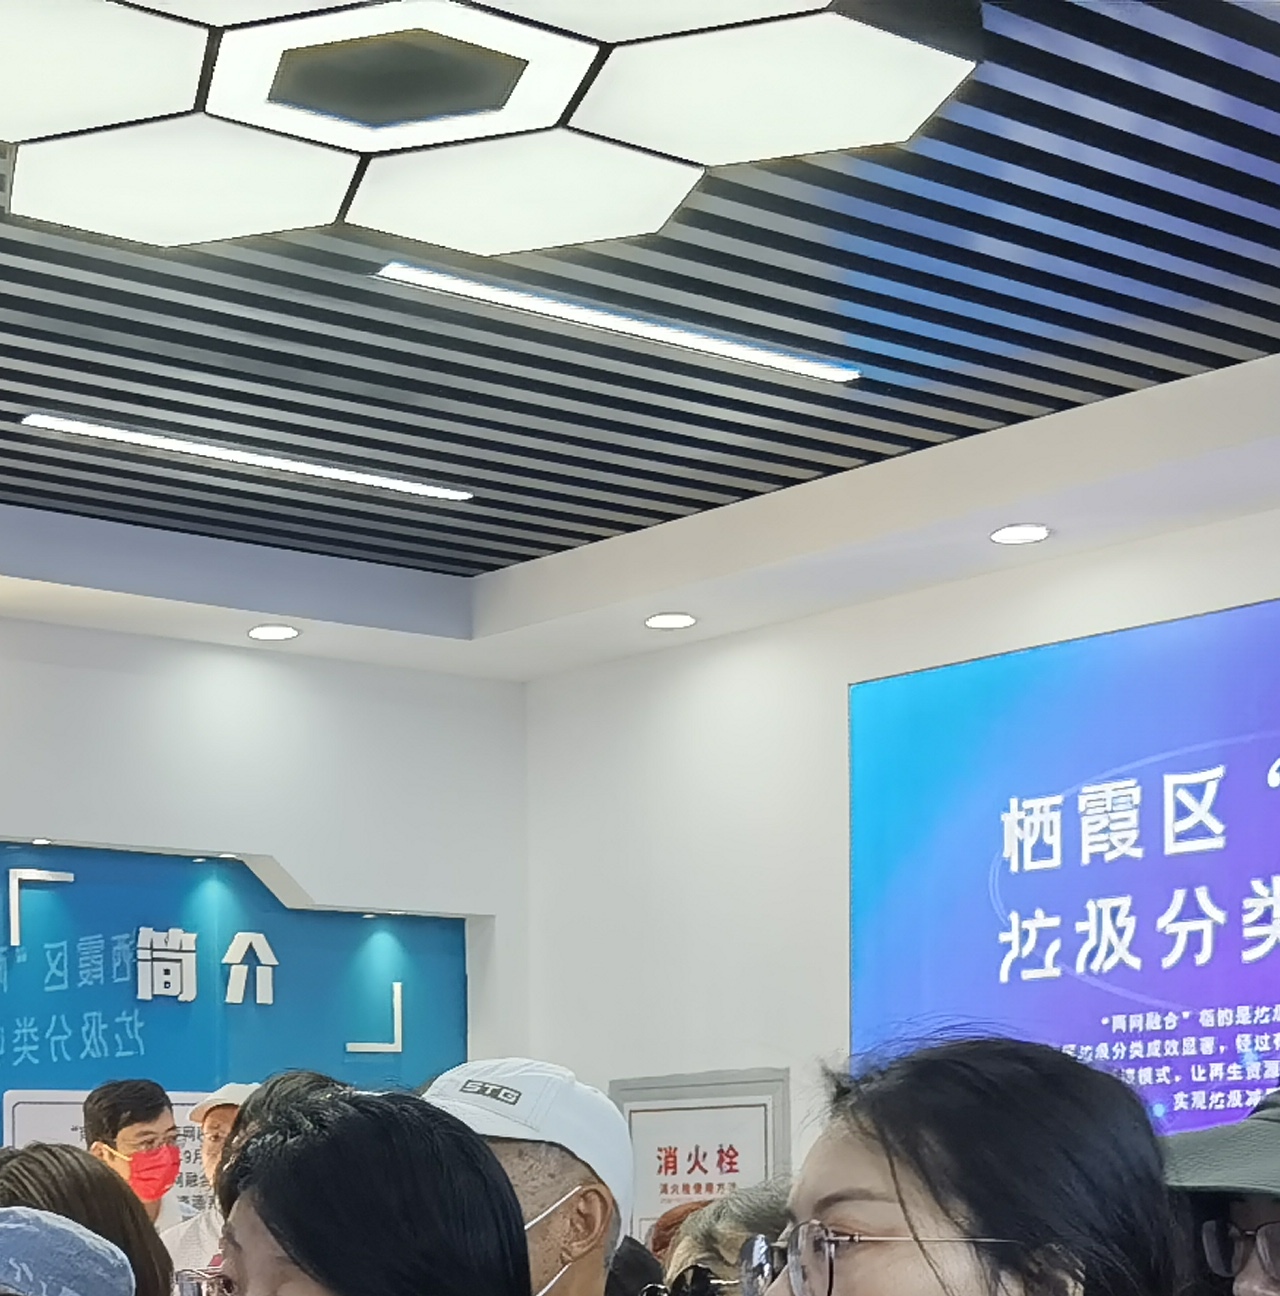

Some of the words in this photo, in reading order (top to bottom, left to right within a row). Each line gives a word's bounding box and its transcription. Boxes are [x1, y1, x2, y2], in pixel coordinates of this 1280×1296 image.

[136, 927, 279, 1004] 简介
[657, 1144, 739, 1176] 消火栓
